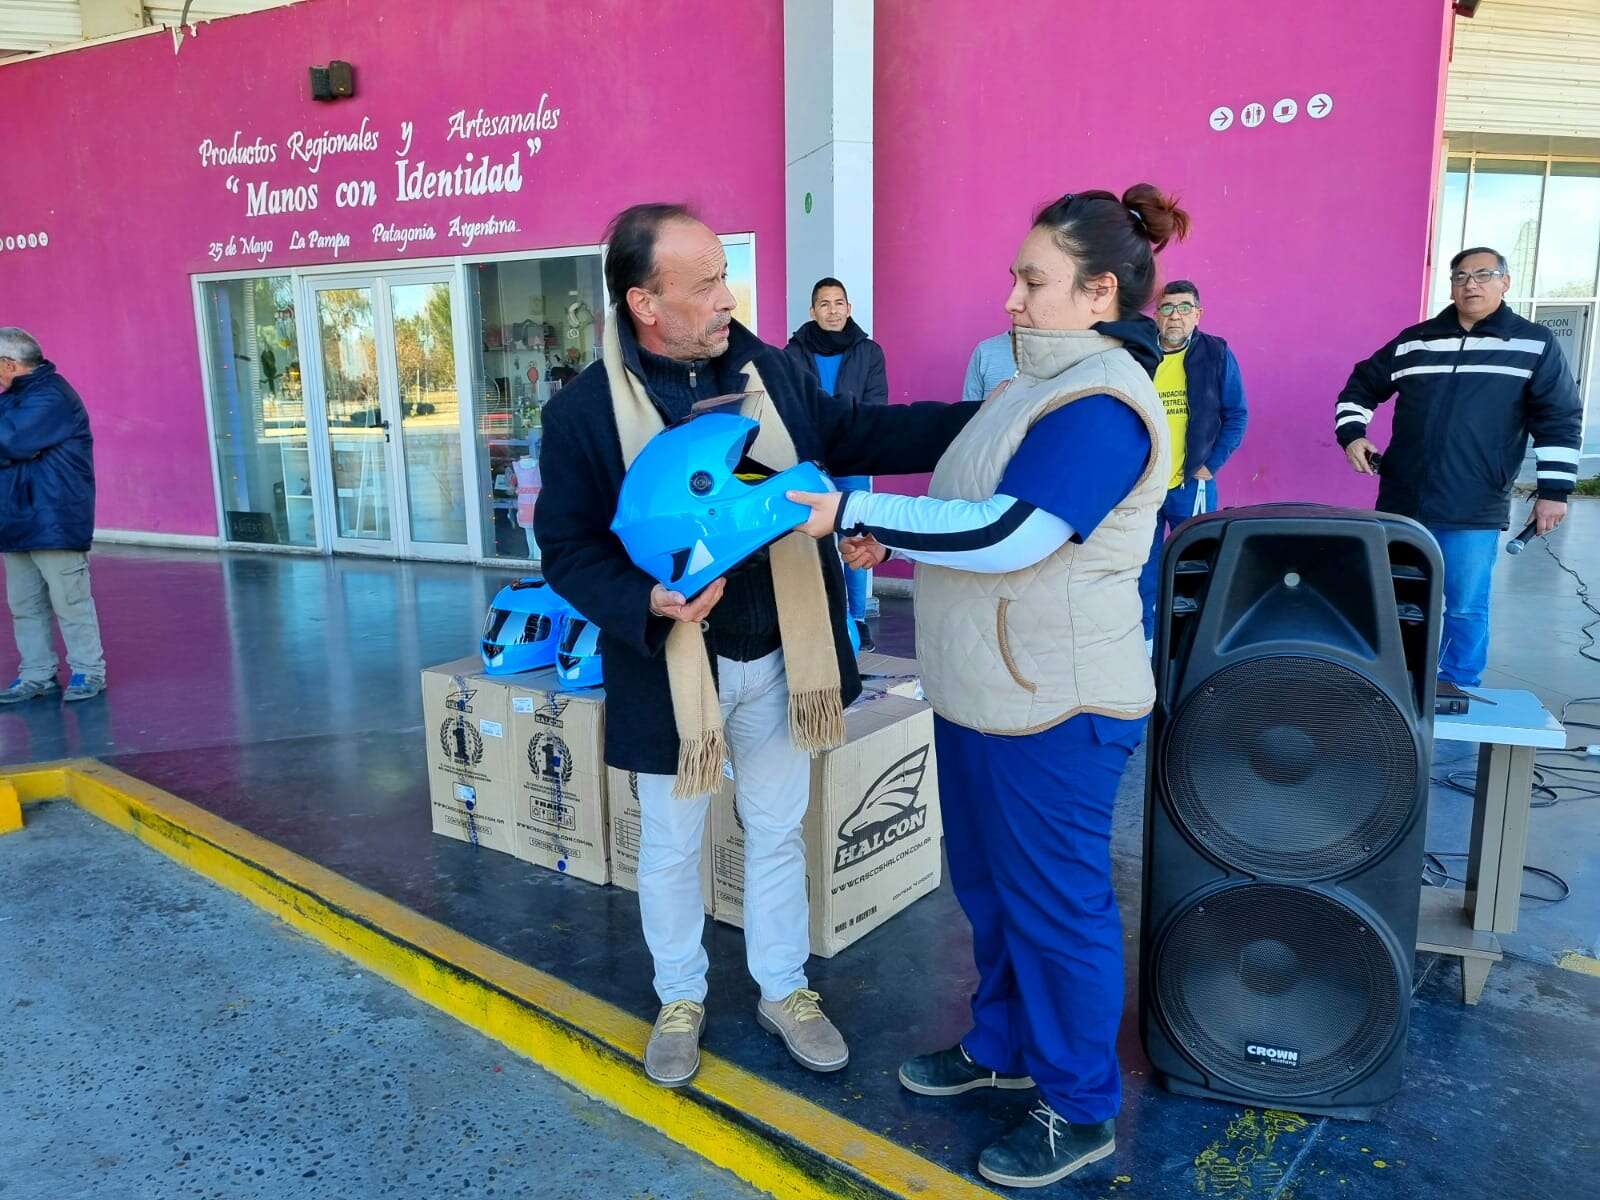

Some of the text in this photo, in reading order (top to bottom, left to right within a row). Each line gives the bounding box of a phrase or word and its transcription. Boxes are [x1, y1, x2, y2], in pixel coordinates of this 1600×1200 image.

[199, 93, 561, 174] Productos Regionales y Artesanales
[335, 177, 377, 208] con
[208, 242, 223, 262] 25
[225, 235, 237, 256] de
[240, 236, 273, 263] Mayo
[289, 230, 305, 250] La
[308, 230, 350, 258] Pampa
[372, 223, 437, 252] Patagonia
[1536, 318, 1569, 328] ECCION
[1553, 328, 1573, 337] SITO
[837, 809, 925, 867] HALCON
[1247, 1045, 1298, 1061] CROWN
